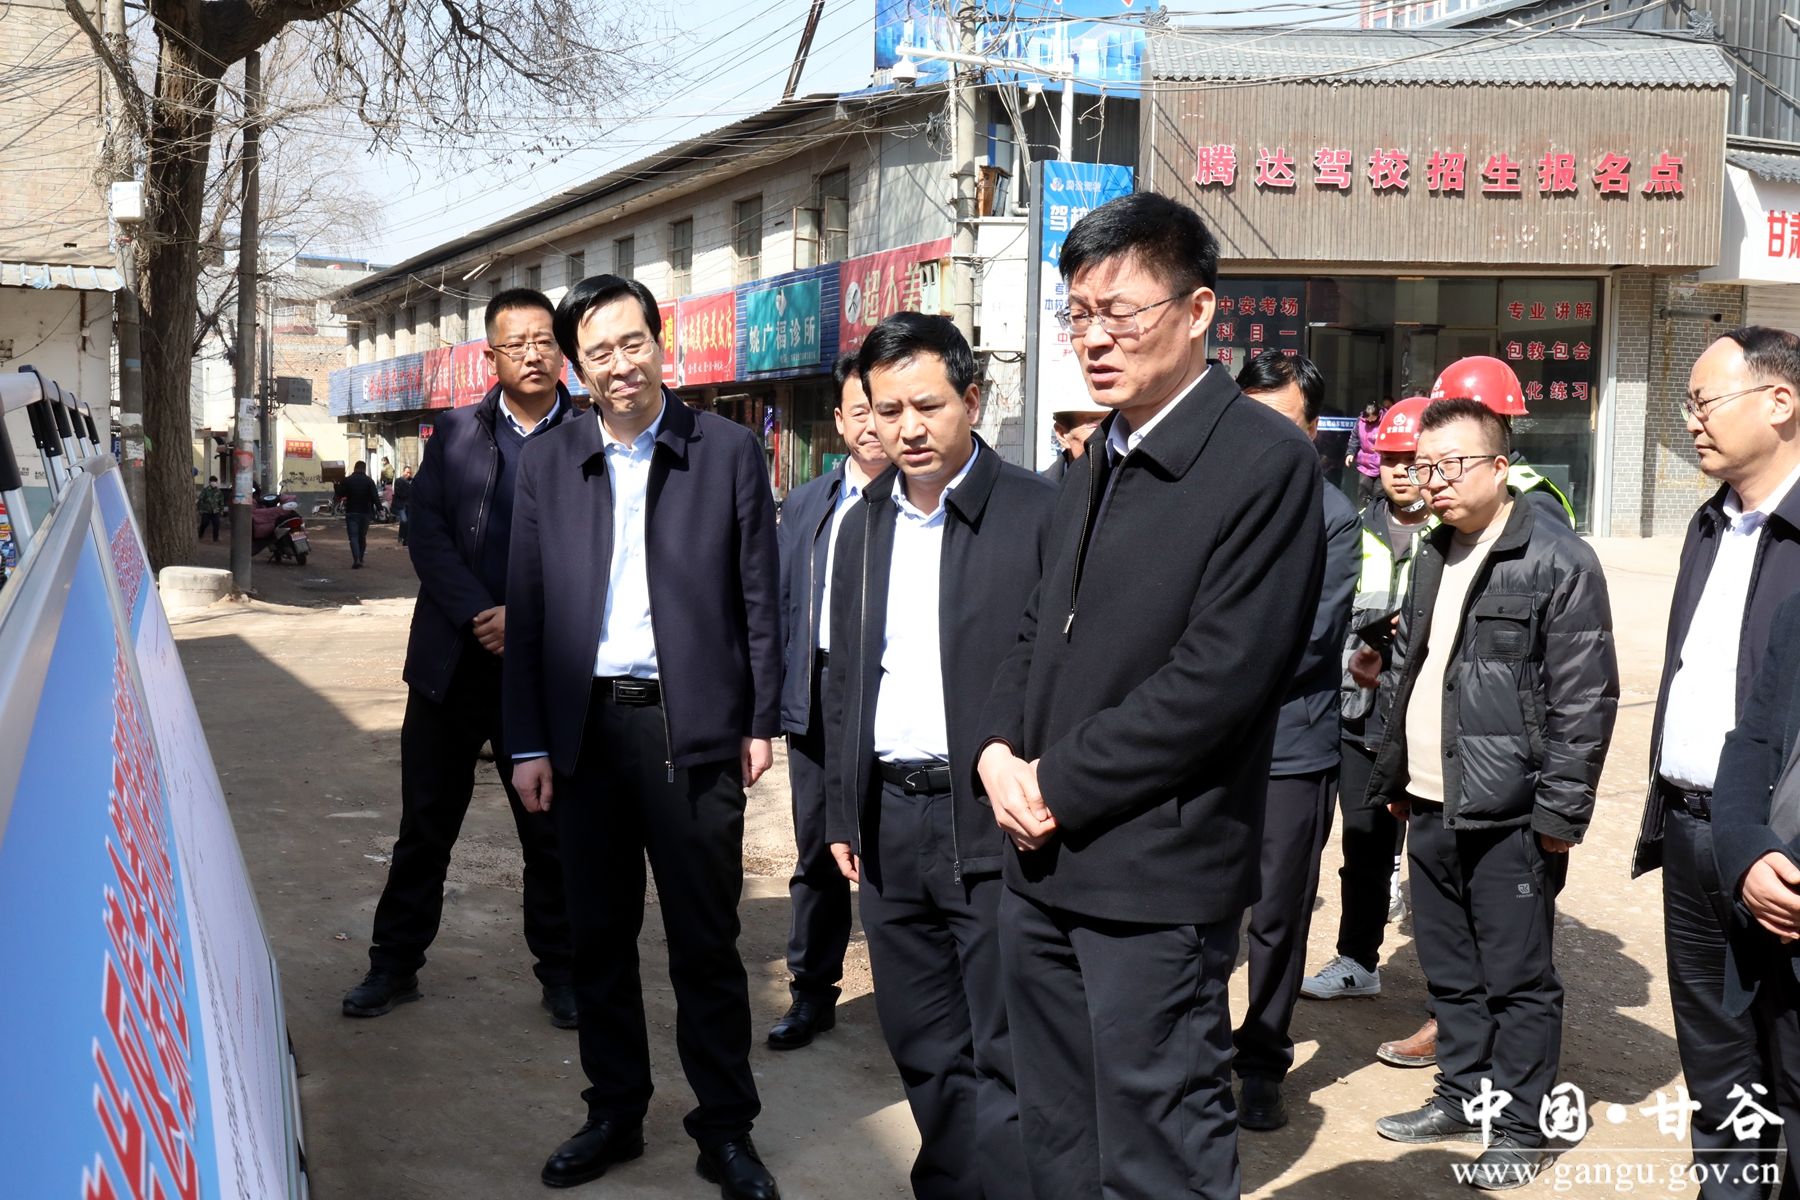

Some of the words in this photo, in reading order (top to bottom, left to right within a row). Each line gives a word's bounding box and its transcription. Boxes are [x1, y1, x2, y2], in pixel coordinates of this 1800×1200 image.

[1196, 144, 1686, 194] 腾达驾校招生报名点
[1218, 296, 1299, 316] 中安考场
[1508, 301, 1593, 320] 专业讲解
[1216, 322, 1297, 341] 科目一
[1506, 341, 1592, 360] 包教包会
[1525, 381, 1589, 400] 化练习
